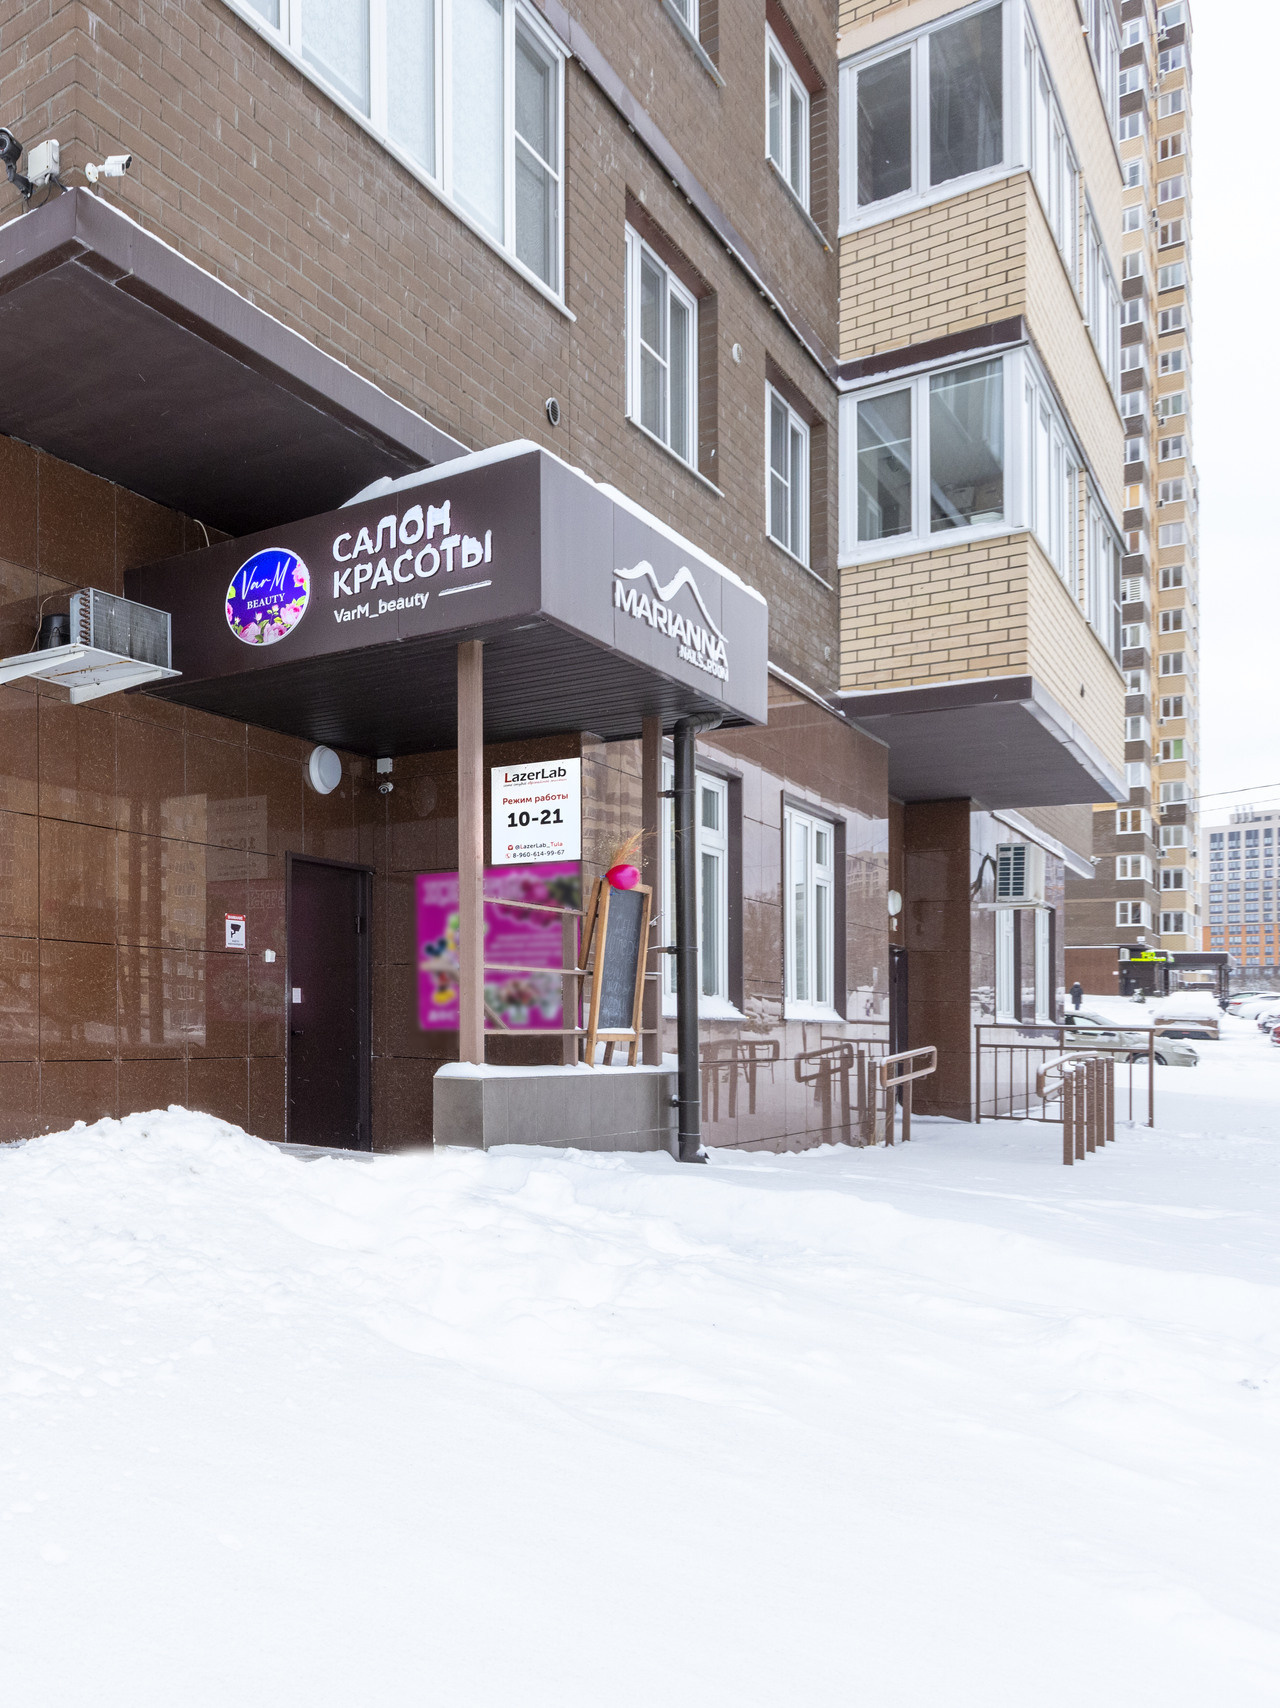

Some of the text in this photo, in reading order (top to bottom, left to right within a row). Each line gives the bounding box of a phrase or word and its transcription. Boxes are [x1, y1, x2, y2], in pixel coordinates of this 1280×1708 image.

[332, 499, 451, 562] САЛОН
[333, 529, 493, 599] КРАСОТЫ
[246, 593, 286, 610] BEAUTY
[333, 591, 430, 623] VarM_beauty
[614, 579, 729, 668] MARIANNA
[504, 767, 566, 783] LazerLab
[502, 793, 569, 805] Режим работы
[507, 808, 563, 827] 10-21
[512, 849, 565, 859] 8-960-614-99-67
[514, 841, 564, 850] @LazerLab_Tula
